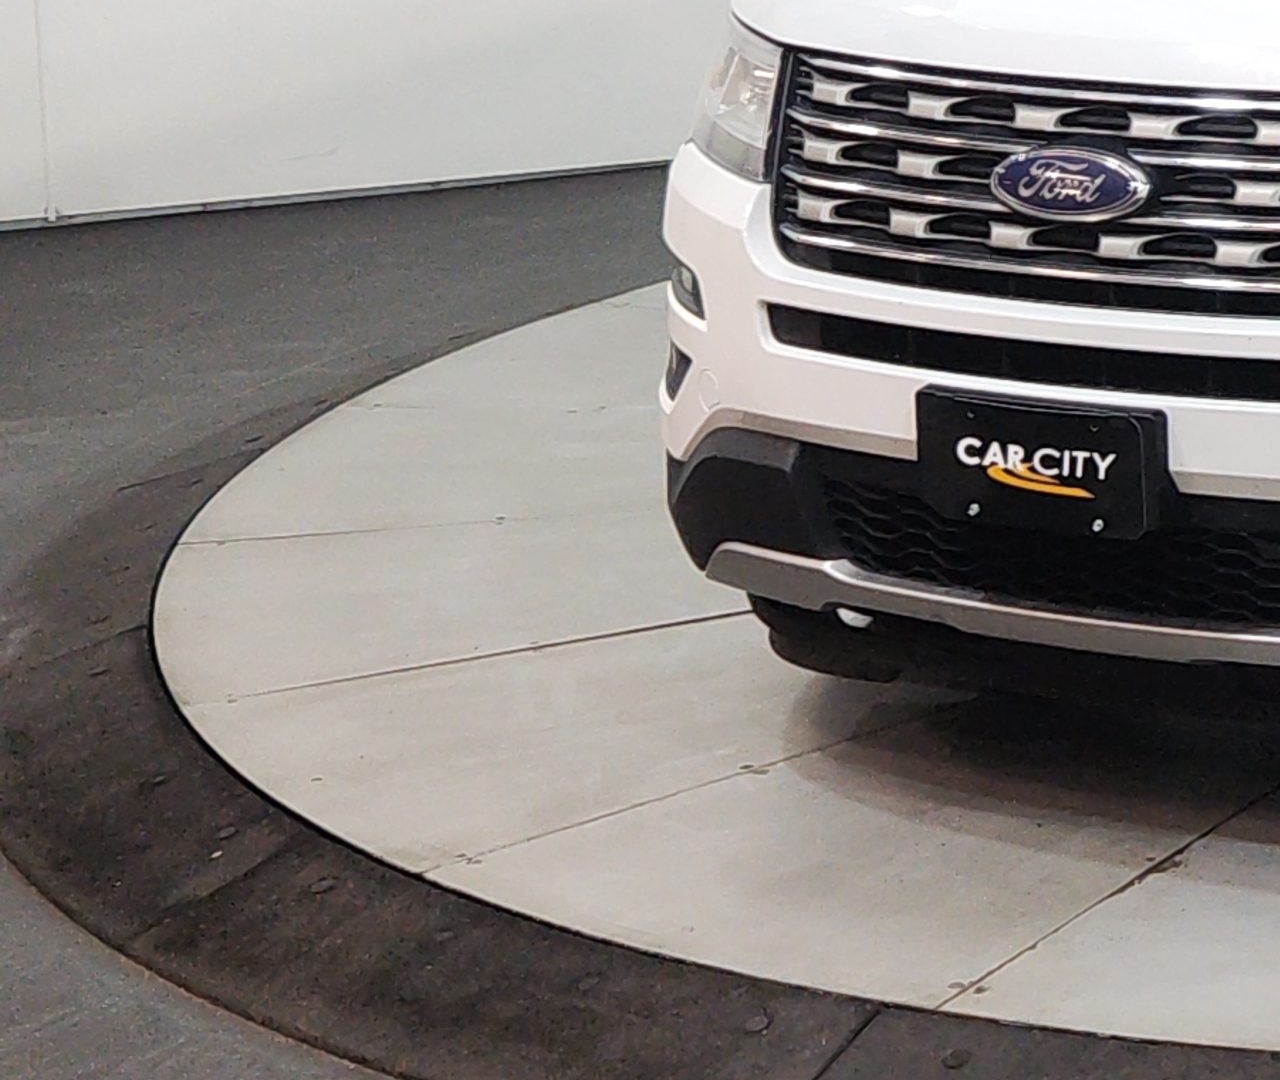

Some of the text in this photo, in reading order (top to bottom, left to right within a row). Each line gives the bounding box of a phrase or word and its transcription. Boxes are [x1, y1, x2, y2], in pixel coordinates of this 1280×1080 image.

[1018, 159, 1106, 203] Ford
[956, 436, 1117, 480] CAR CITY
